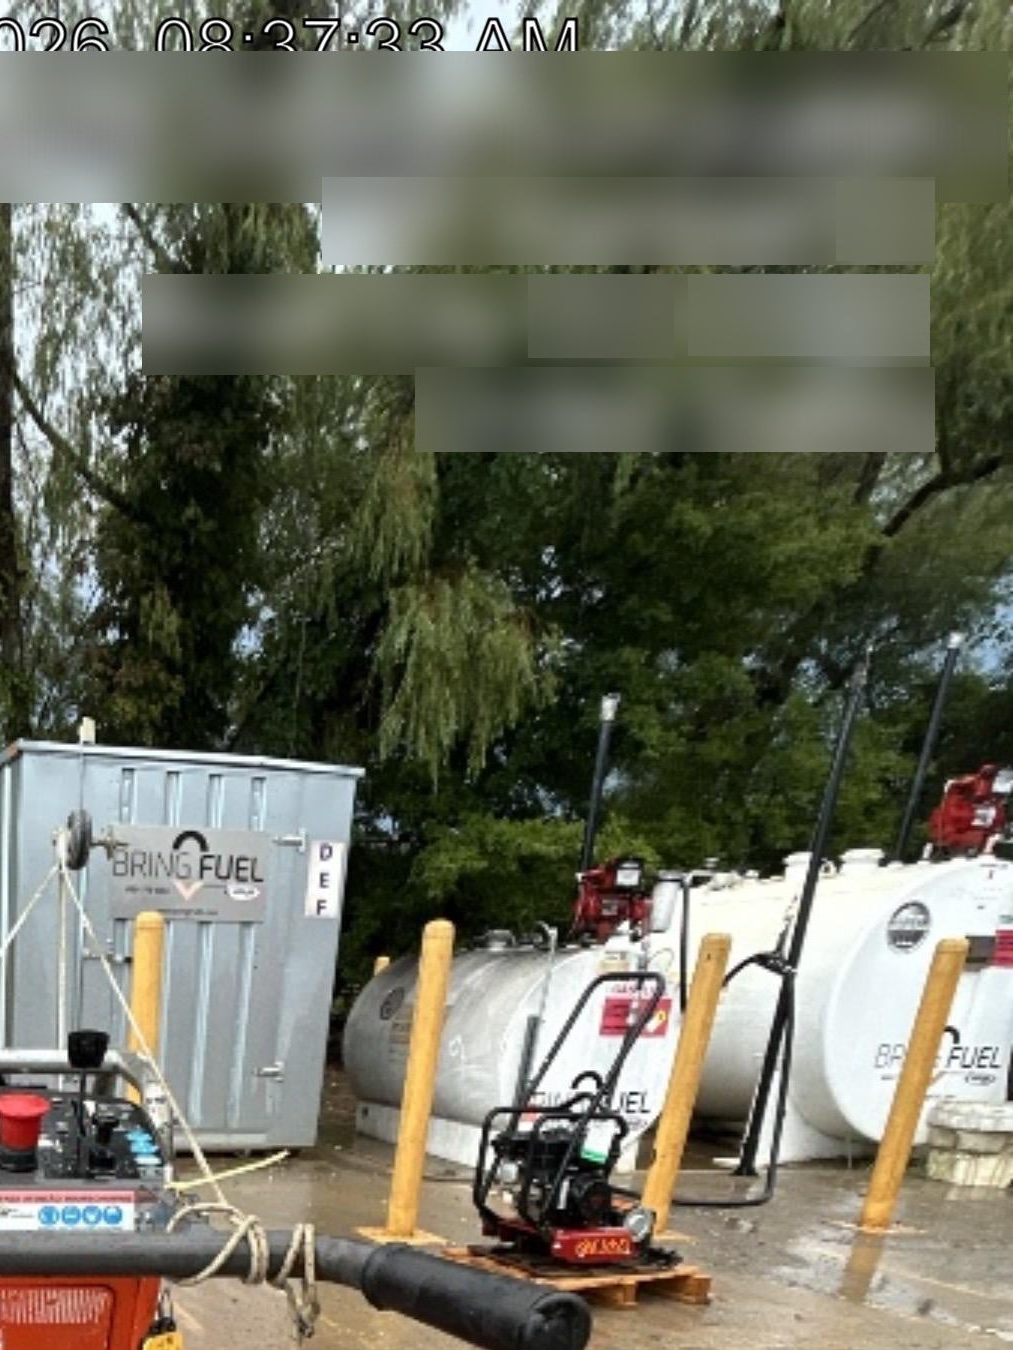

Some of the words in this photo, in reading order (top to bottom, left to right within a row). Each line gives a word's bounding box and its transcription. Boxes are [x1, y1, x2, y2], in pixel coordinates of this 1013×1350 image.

[112, 848, 190, 880] BRING
[199, 854, 264, 883] FUEL
[945, 1046, 1001, 1069] FUEL
